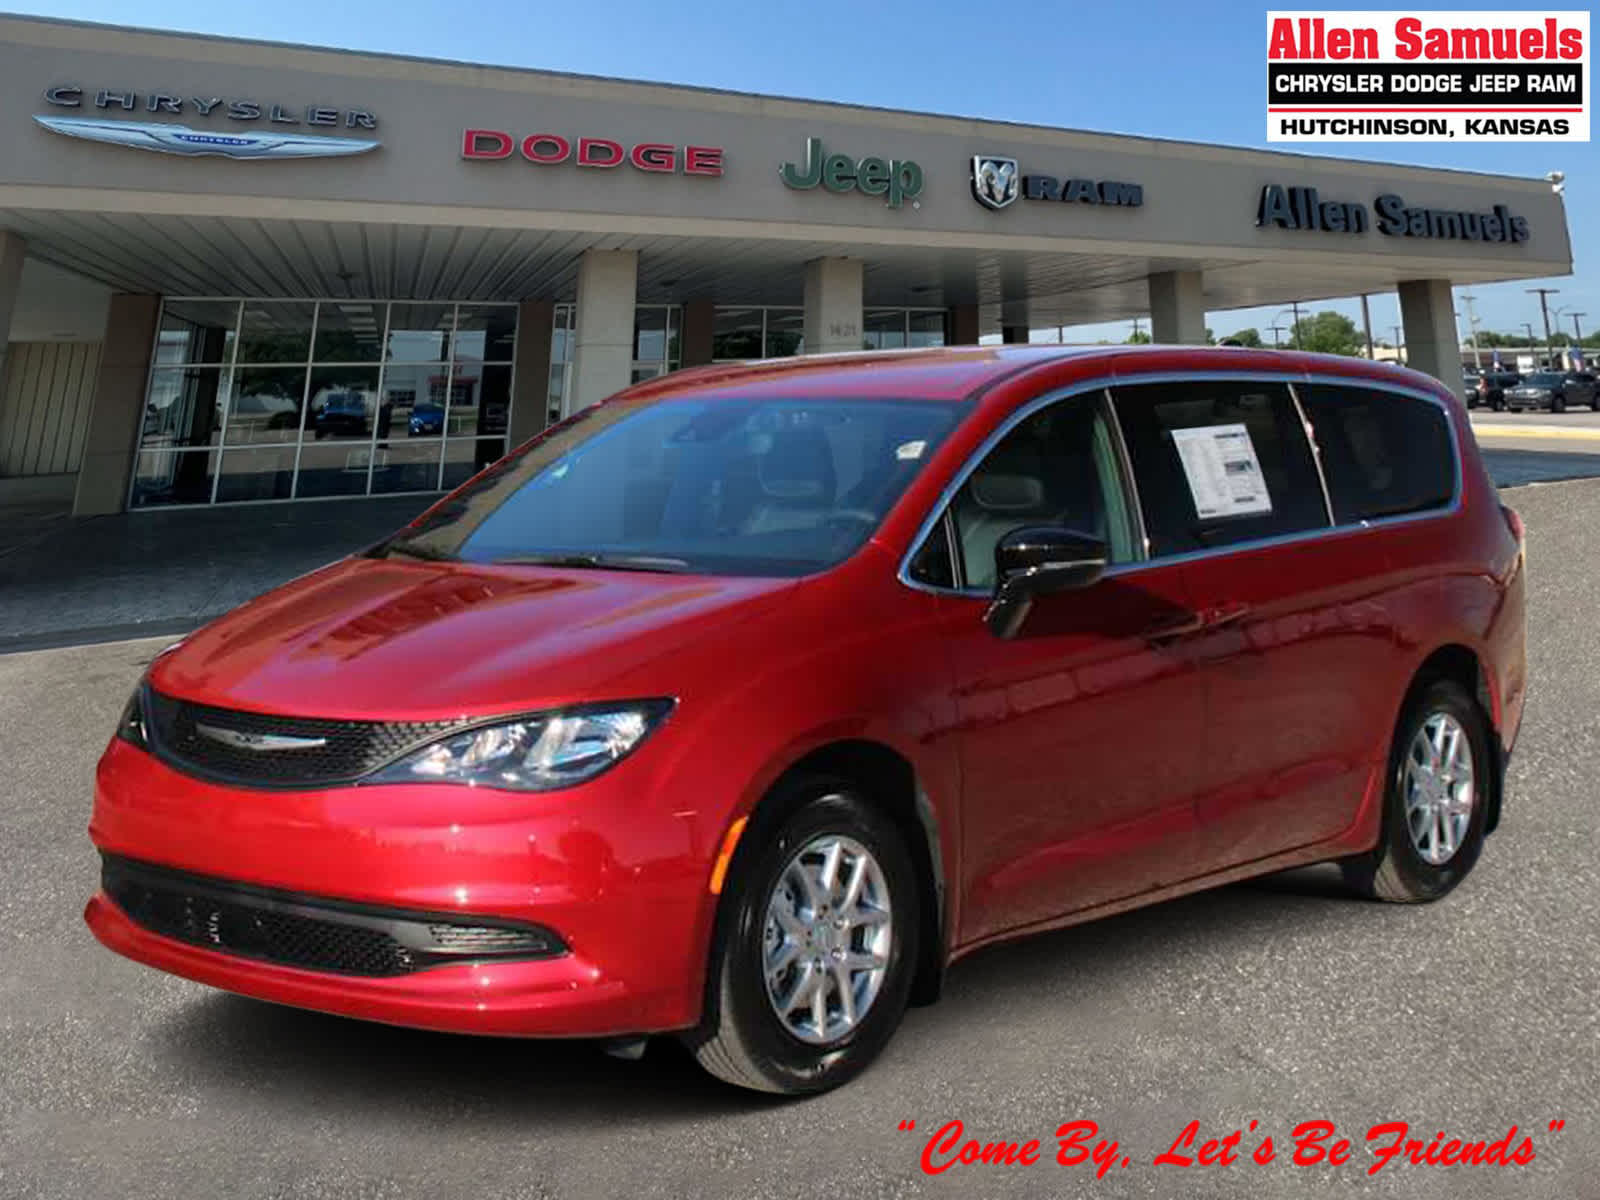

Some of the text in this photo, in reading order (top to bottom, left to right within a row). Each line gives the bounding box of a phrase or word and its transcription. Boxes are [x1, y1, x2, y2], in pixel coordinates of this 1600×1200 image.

[44, 86, 377, 129] CHRYSLER
[462, 128, 725, 177] DODGE
[779, 137, 924, 209] Jeep
[1023, 175, 1144, 207] RAM
[1256, 184, 1530, 243] Allen Samuels
